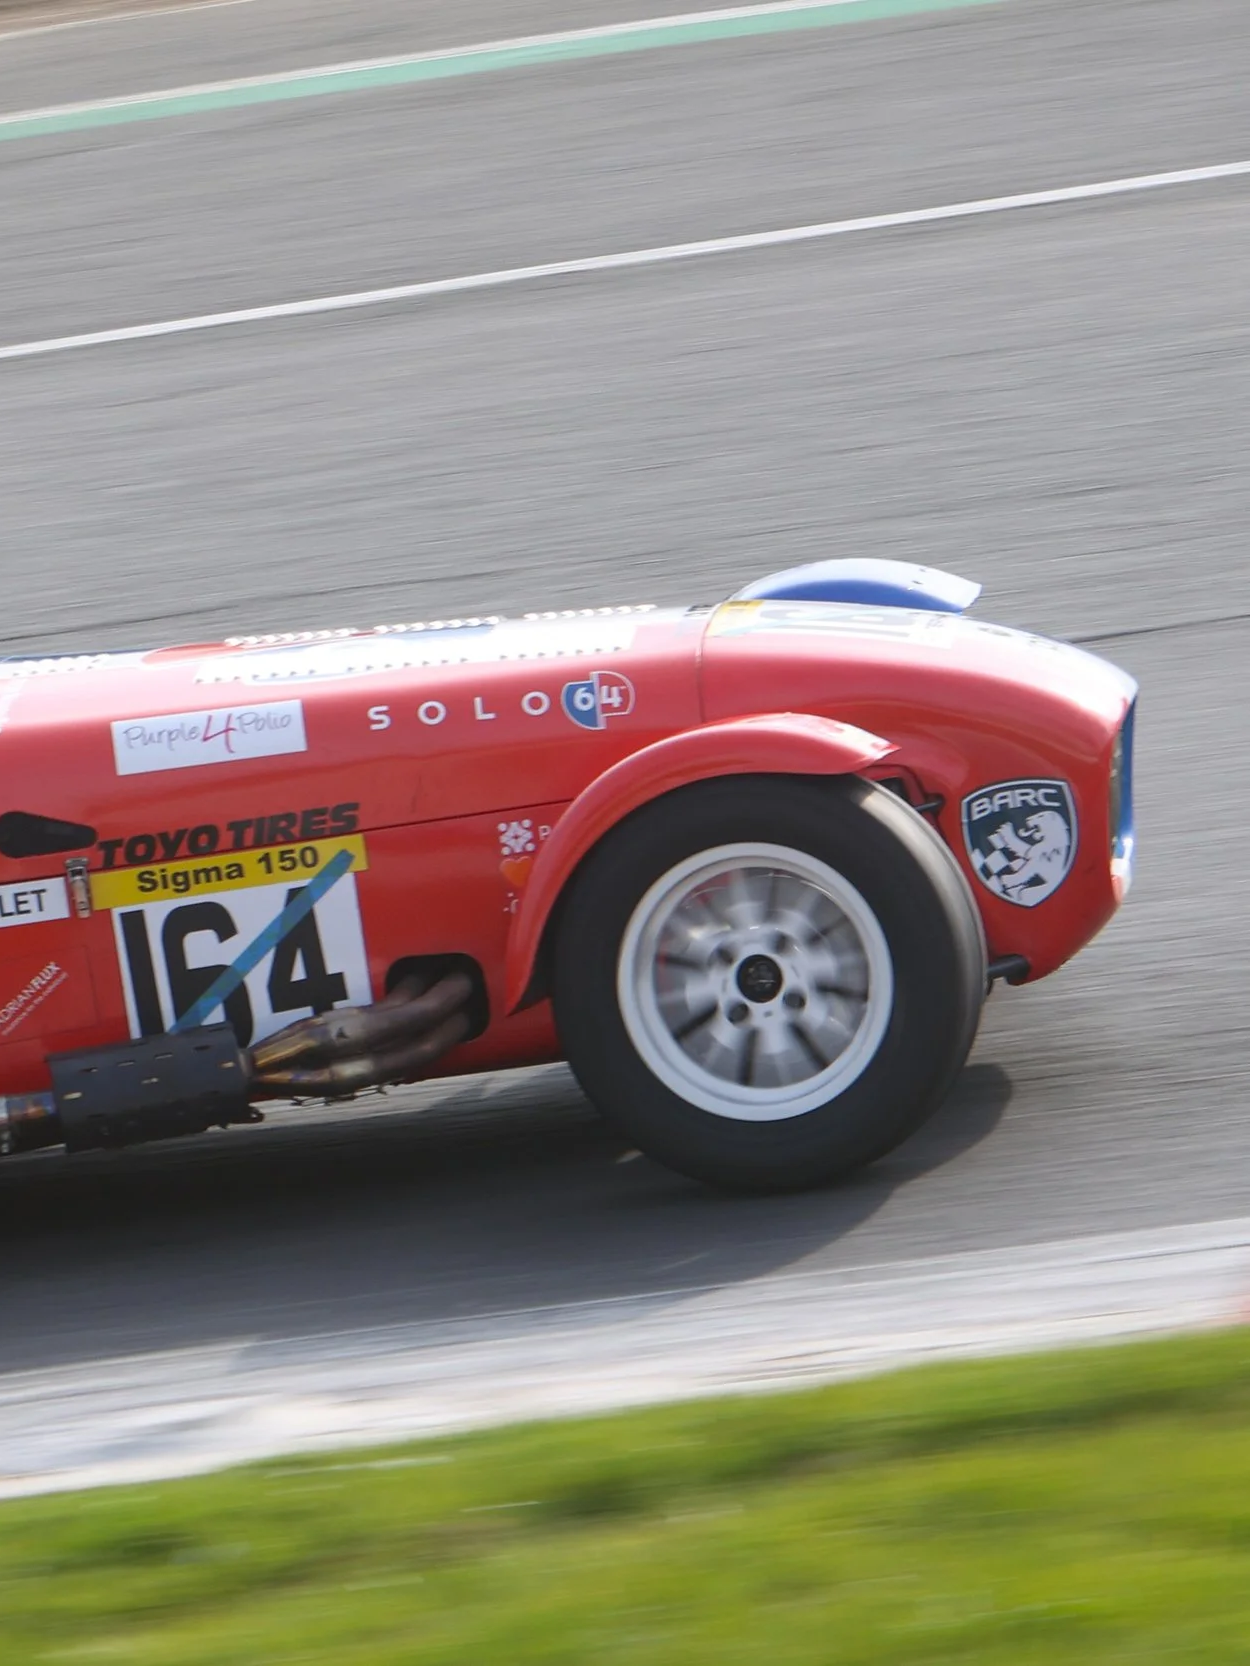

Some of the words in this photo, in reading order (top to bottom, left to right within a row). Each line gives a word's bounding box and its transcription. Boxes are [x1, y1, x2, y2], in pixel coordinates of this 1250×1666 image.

[367, 691, 551, 731] SOLO
[573, 685, 625, 712] 64
[970, 788, 1062, 821] BARC
[97, 824, 220, 869] TOYO
[227, 802, 360, 848] TIRES
[137, 860, 245, 894] Sigma
[257, 846, 320, 875] 150
[119, 885, 348, 1048] 164
